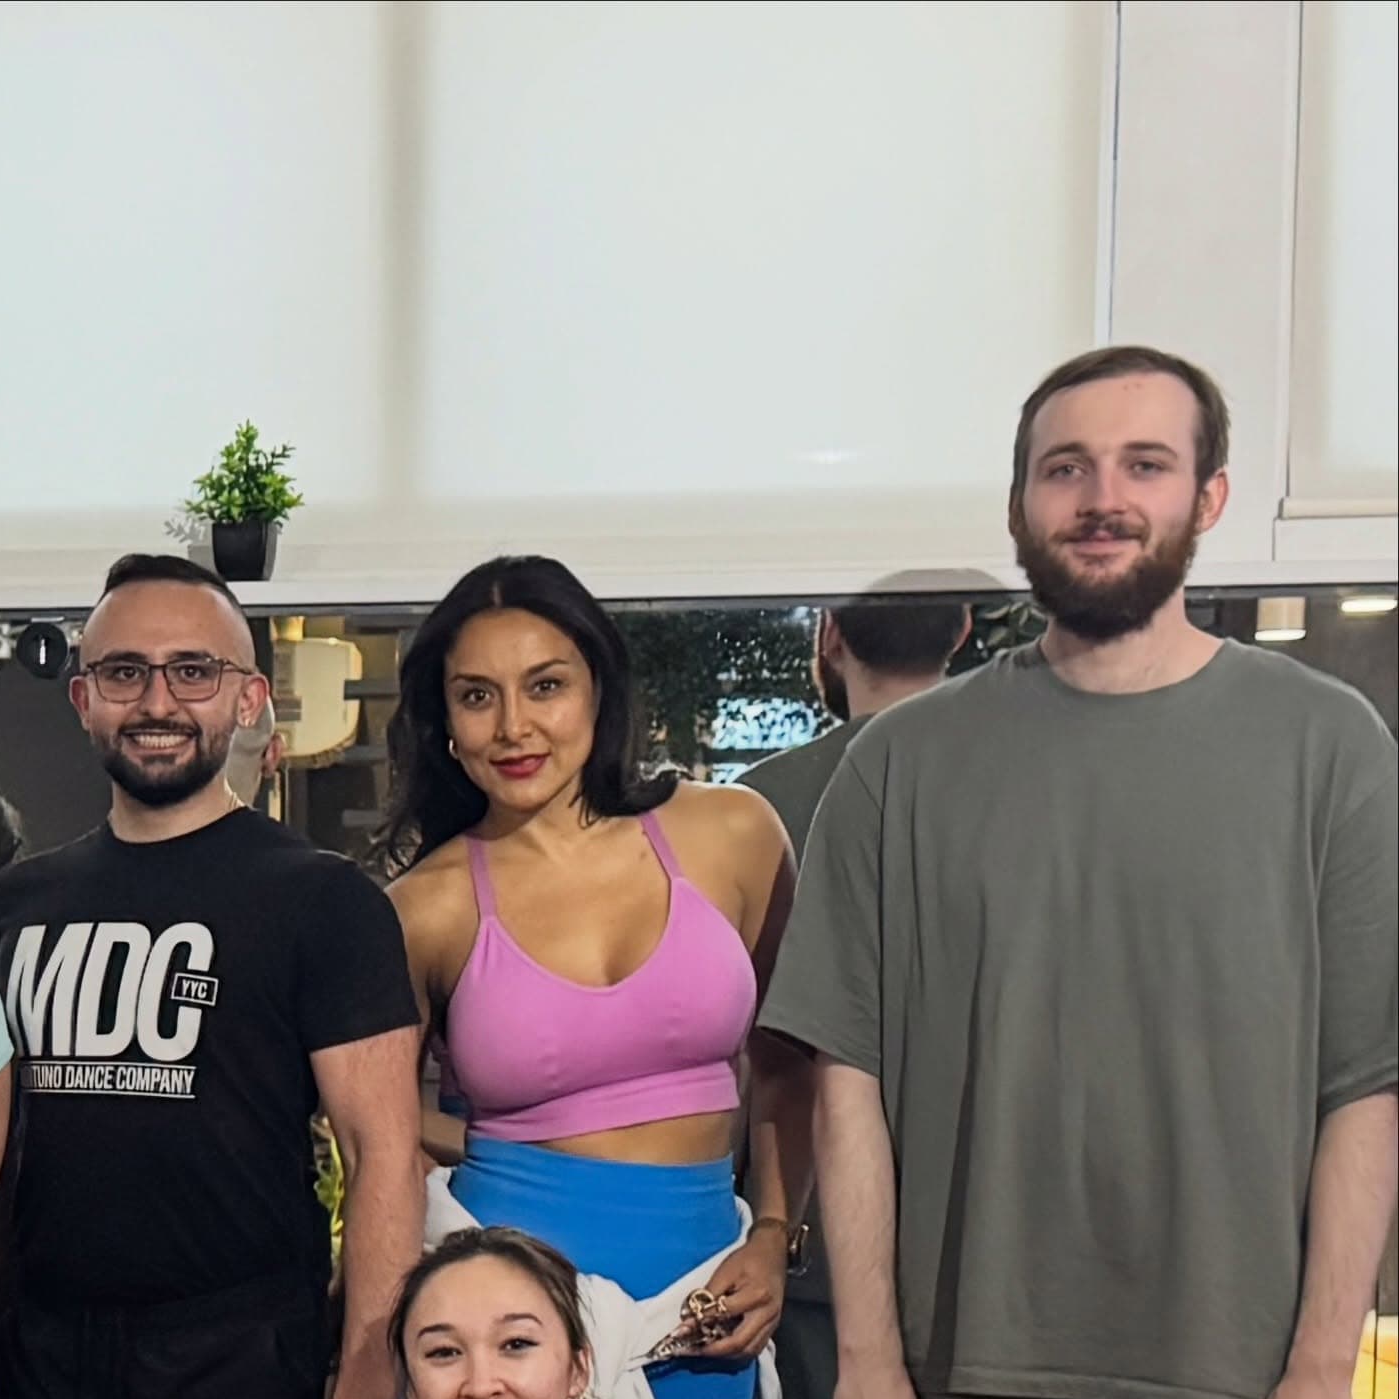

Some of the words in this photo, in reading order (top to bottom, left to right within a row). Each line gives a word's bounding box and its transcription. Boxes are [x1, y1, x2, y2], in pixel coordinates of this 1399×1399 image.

[6, 922, 214, 1062] MDC
[182, 979, 208, 999] YYC
[65, 1065, 115, 1090] DANCE
[115, 1065, 195, 1095] COMPANY
